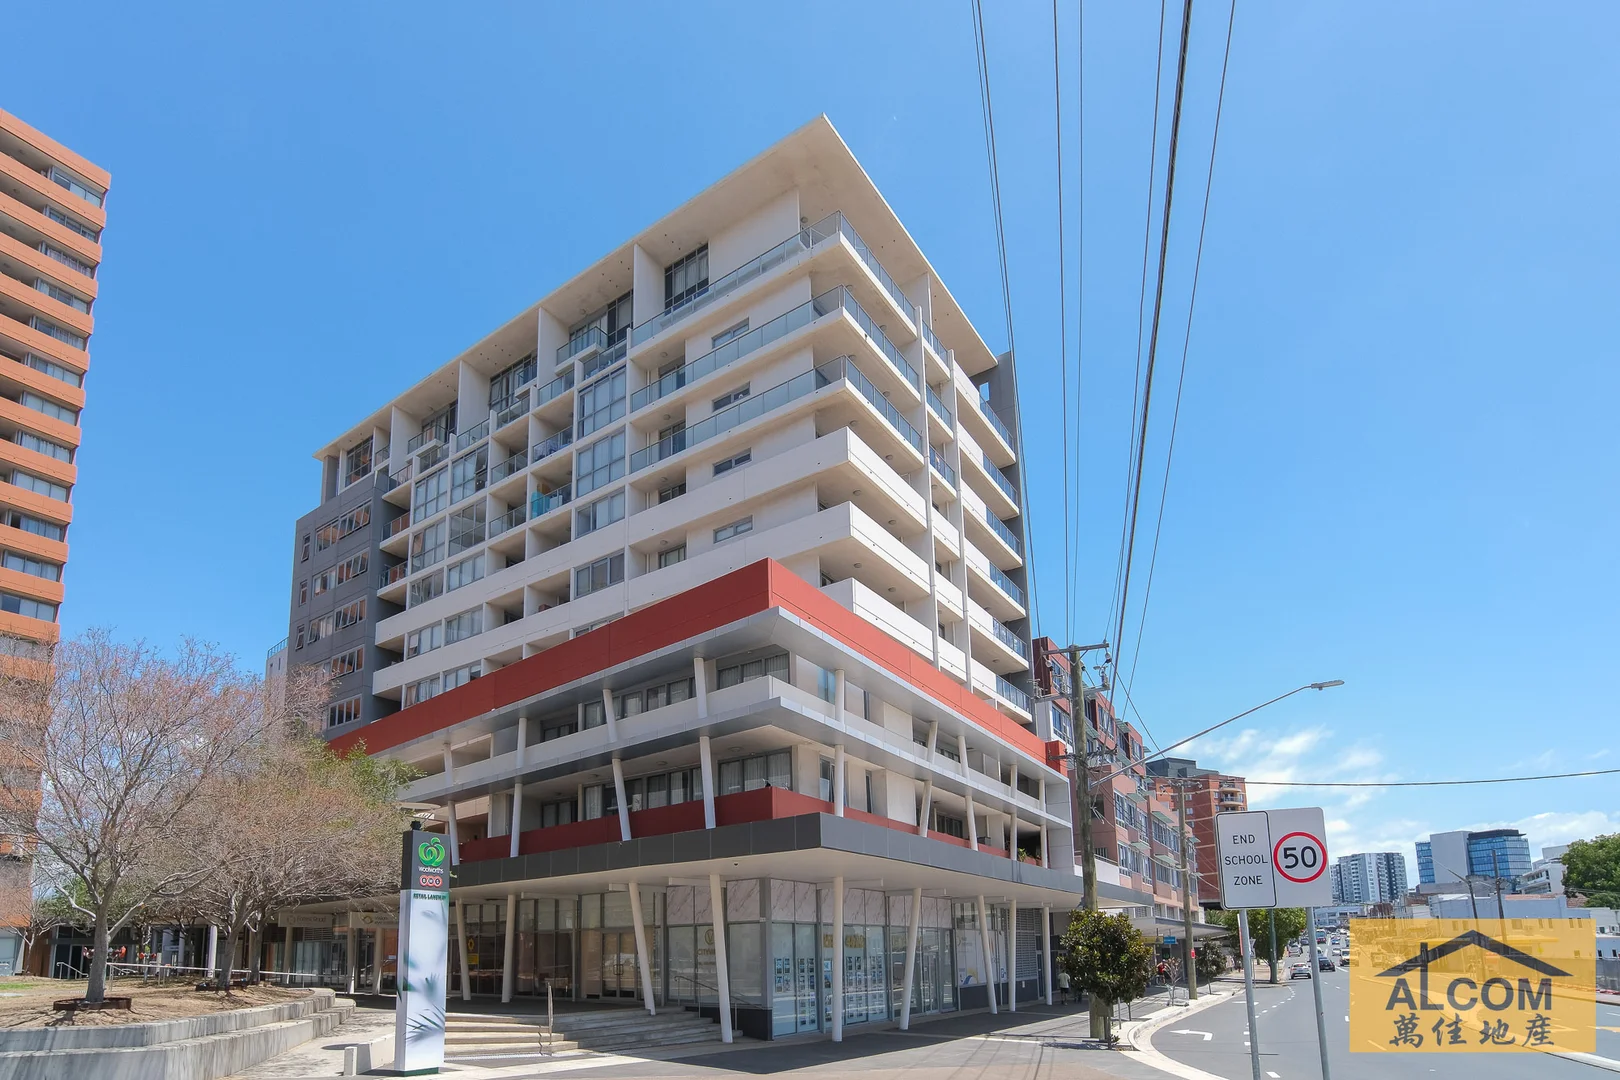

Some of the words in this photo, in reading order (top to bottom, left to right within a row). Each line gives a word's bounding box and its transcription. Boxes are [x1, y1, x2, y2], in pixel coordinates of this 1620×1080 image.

[1233, 835, 1255, 844] END
[1224, 855, 1268, 865] SCHOOL
[1283, 846, 1317, 869] 50
[1234, 875, 1263, 885] ZONE
